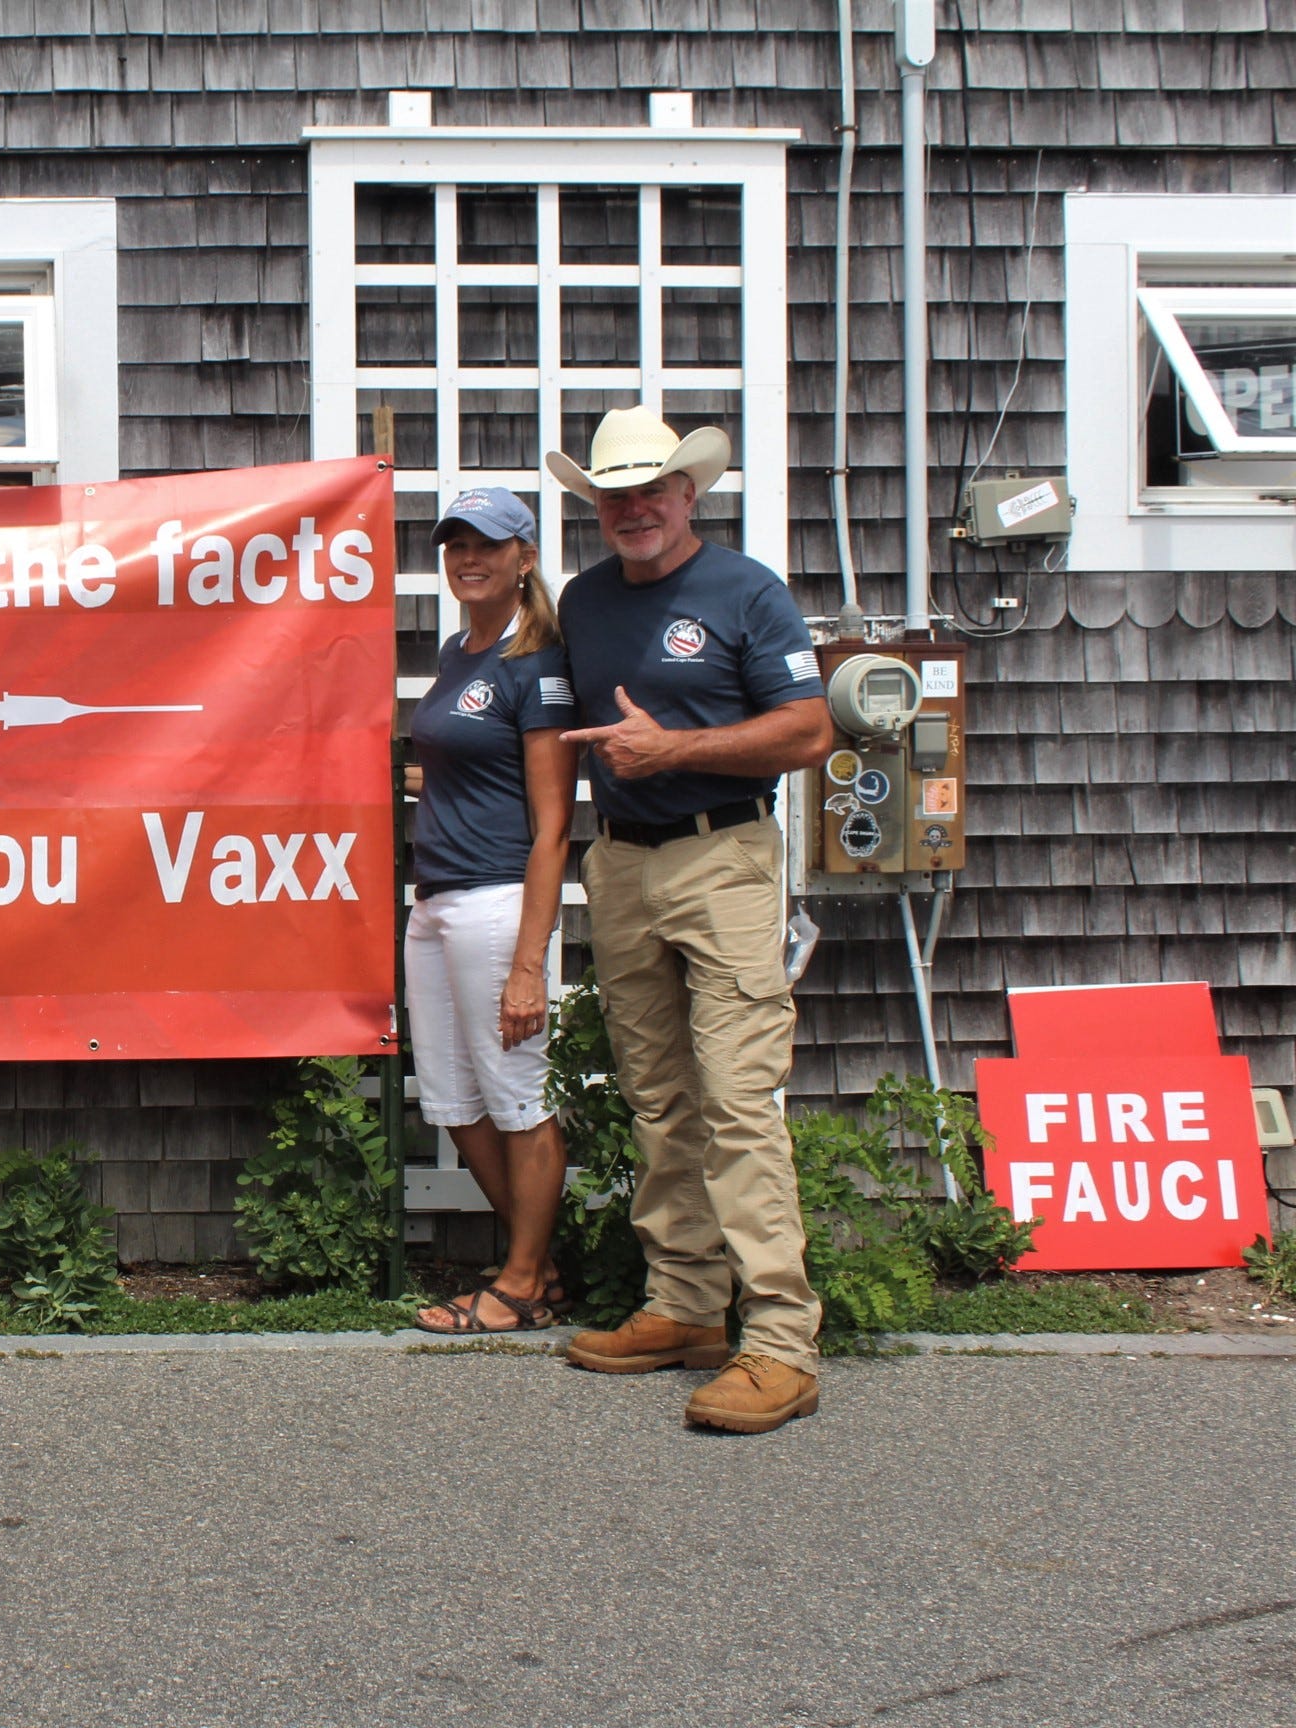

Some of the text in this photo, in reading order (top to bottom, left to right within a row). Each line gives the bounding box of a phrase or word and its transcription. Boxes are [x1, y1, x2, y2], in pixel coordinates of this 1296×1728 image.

[1185, 365, 1296, 435] PE
[150, 516, 374, 607] facts
[926, 680, 954, 690] KIND
[932, 666, 947, 676] BE
[142, 811, 359, 905] Vaxx
[1025, 1091, 1210, 1143] FIRE
[1009, 1159, 1239, 1222] FAUCI
